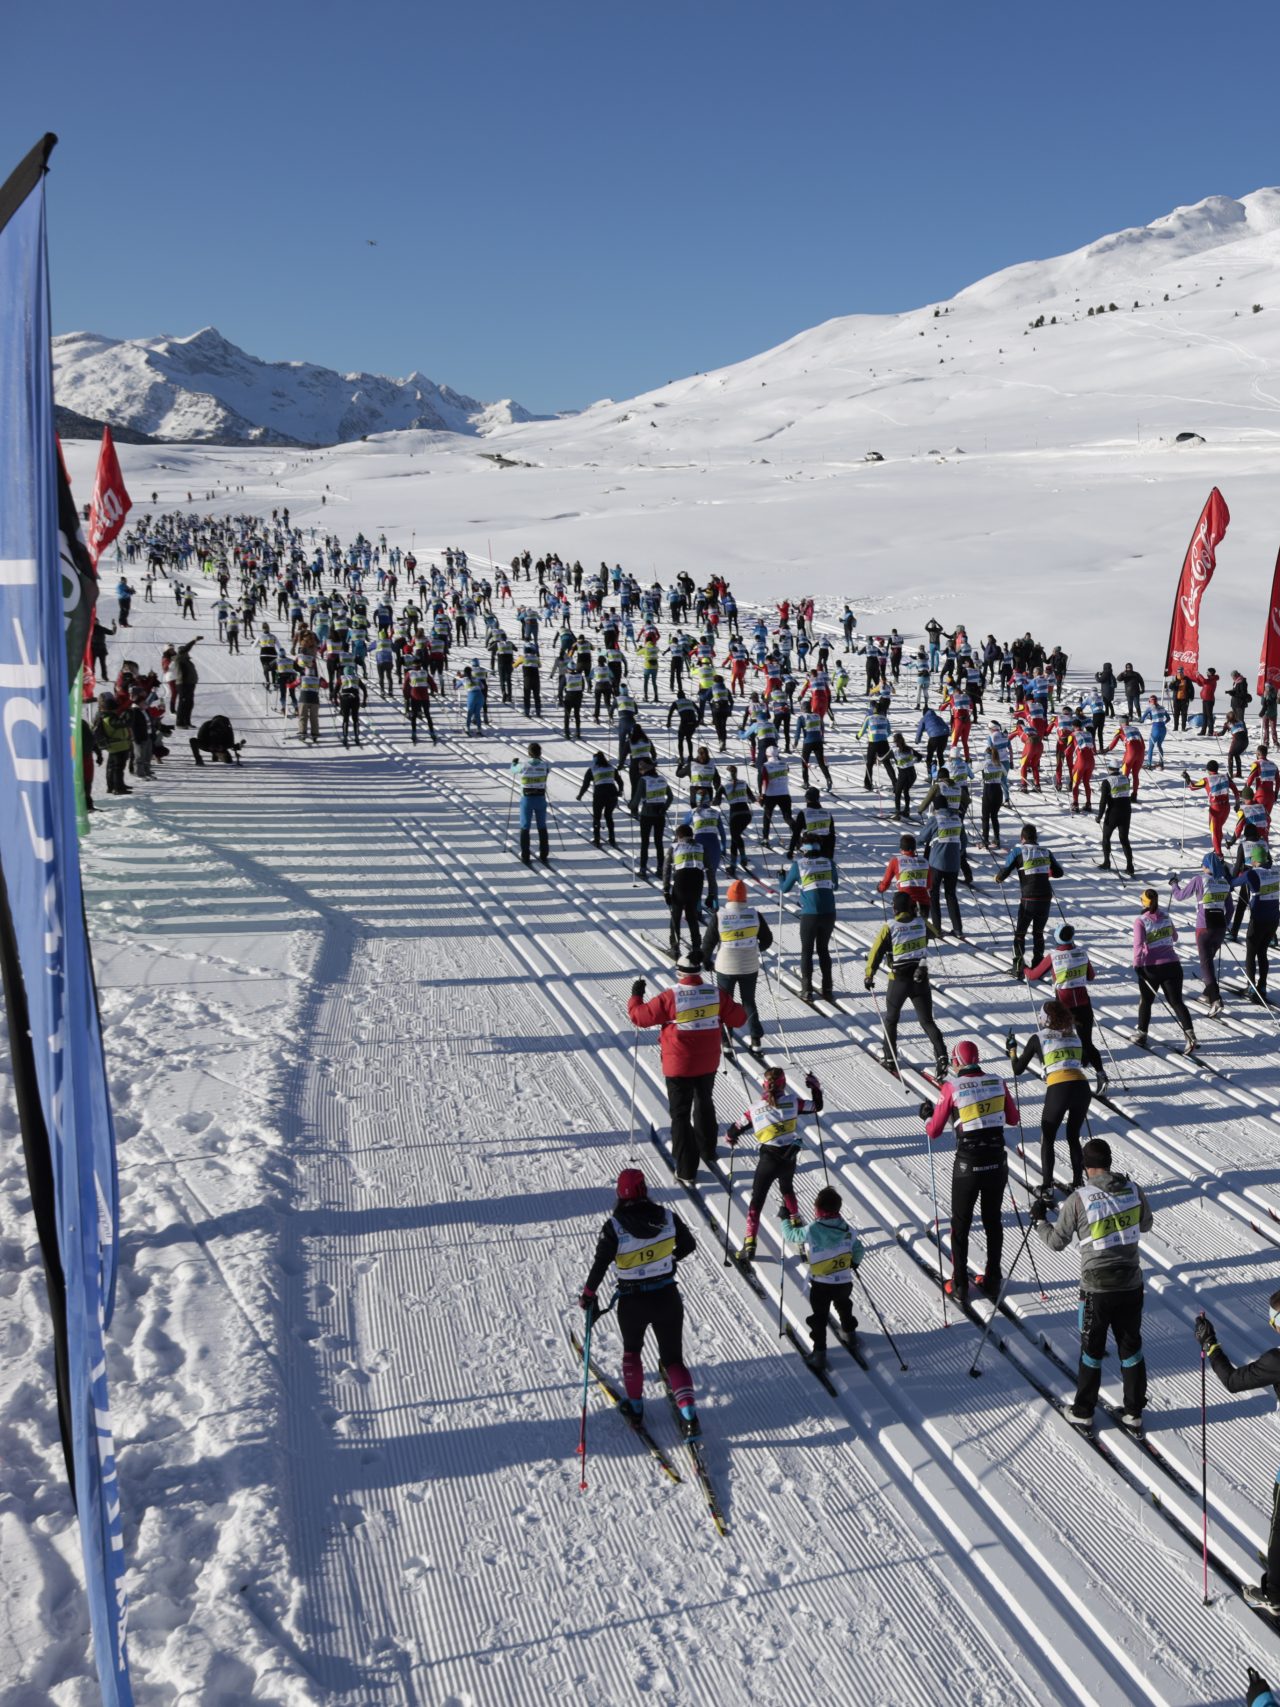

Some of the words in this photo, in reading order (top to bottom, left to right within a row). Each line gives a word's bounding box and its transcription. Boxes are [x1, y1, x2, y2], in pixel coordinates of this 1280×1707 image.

[694, 1009, 705, 1018] 32
[978, 1103, 991, 1114] 37
[1103, 1214, 1131, 1231] 2162
[639, 1250, 654, 1262] 19
[832, 1260, 845, 1270] 26
